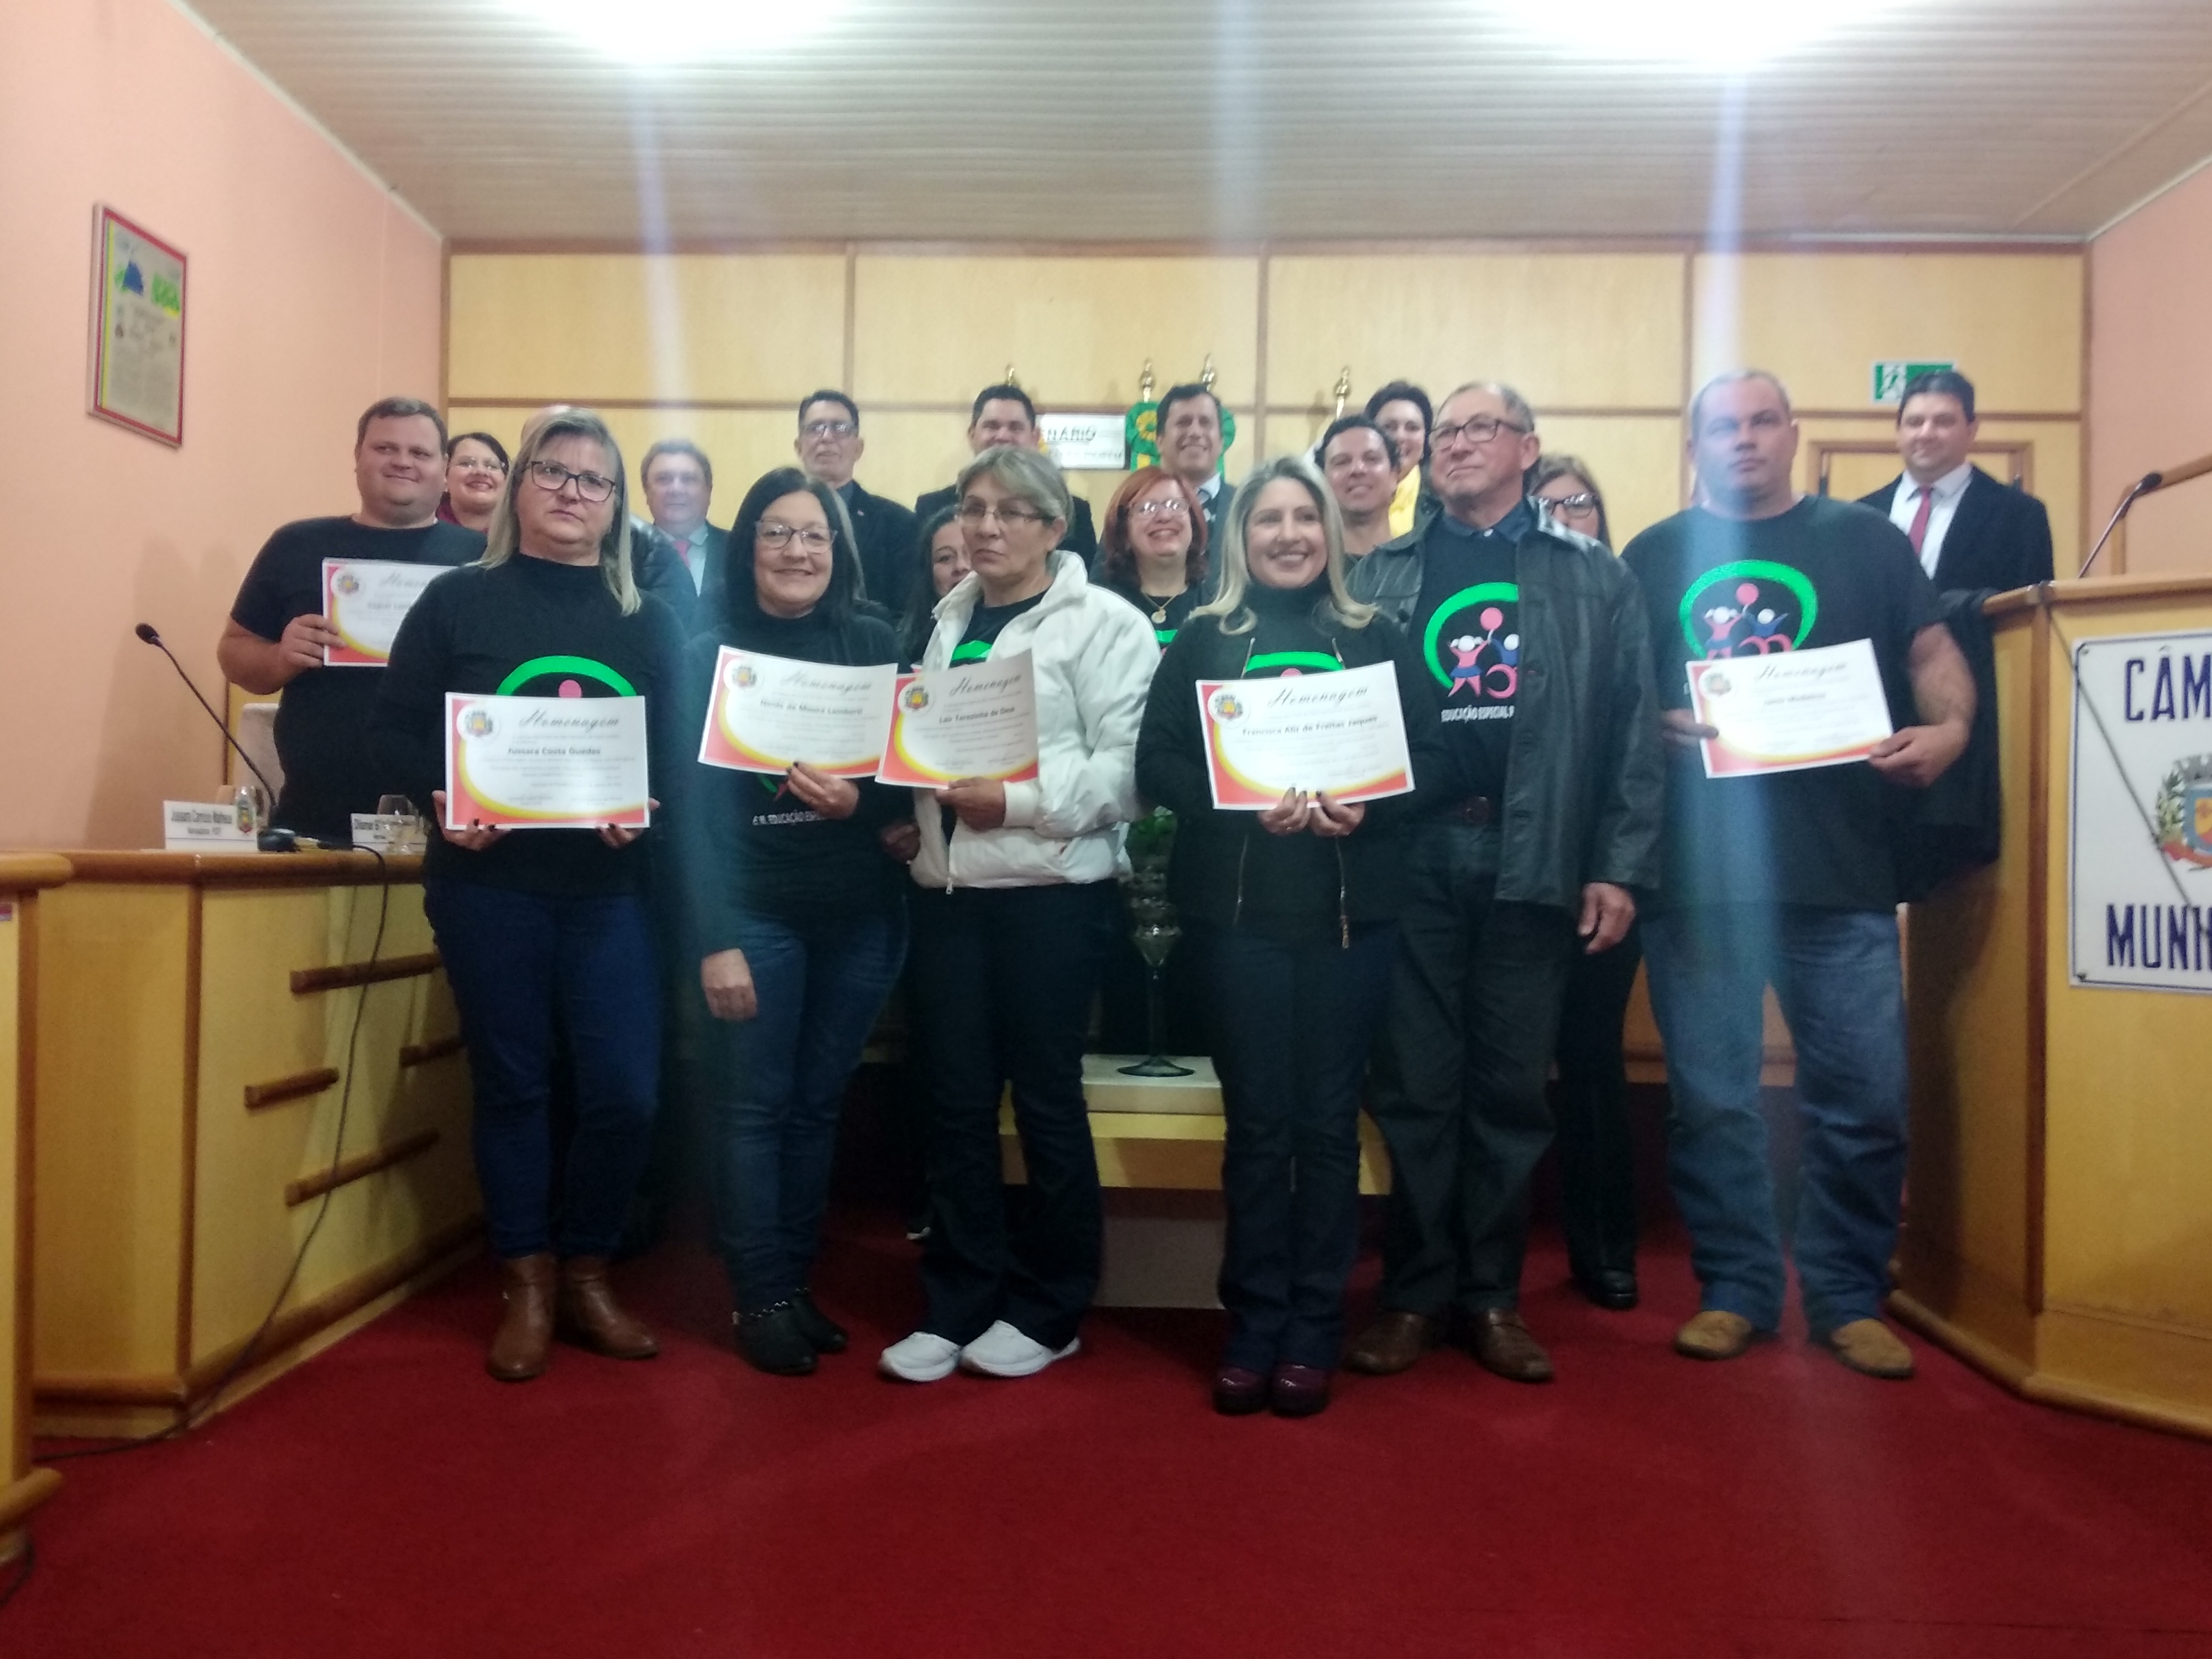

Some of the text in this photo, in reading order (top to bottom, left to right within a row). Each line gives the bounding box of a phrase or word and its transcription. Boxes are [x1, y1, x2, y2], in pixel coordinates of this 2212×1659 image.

[780, 669, 873, 696] Homenagem
[949, 672, 1022, 696] Homenagem
[1267, 687, 1369, 708] Homenagem
[519, 706, 619, 733] Homenagem
[1242, 727, 1282, 737] Francisca
[1302, 724, 1313, 733] de
[2107, 904, 2212, 972] MUNI
